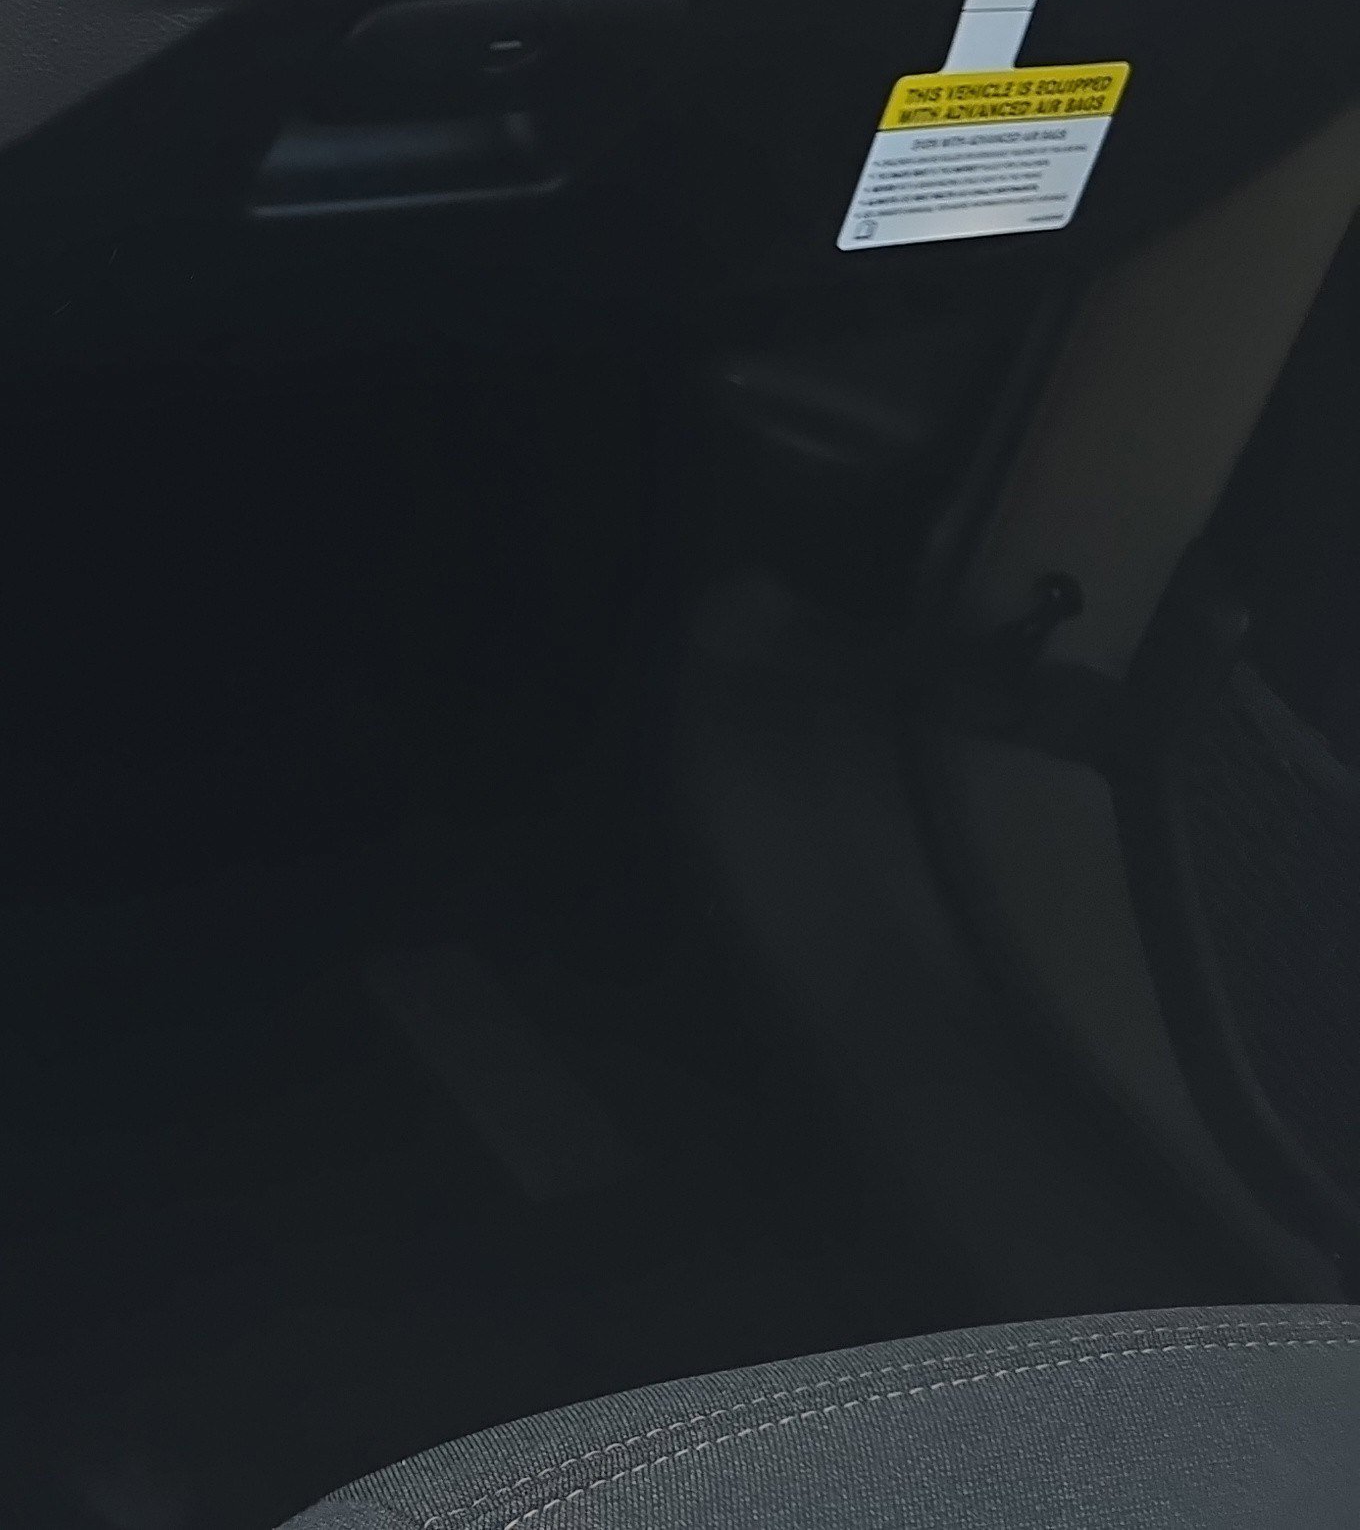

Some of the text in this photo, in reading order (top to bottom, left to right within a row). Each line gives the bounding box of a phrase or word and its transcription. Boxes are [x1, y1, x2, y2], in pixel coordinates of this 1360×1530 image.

[945, 81, 1015, 101] VEHICLE
[1018, 80, 1034, 96] IS
[1035, 75, 1113, 96] EQUIPPED
[944, 99, 1031, 120] ADVANCED
